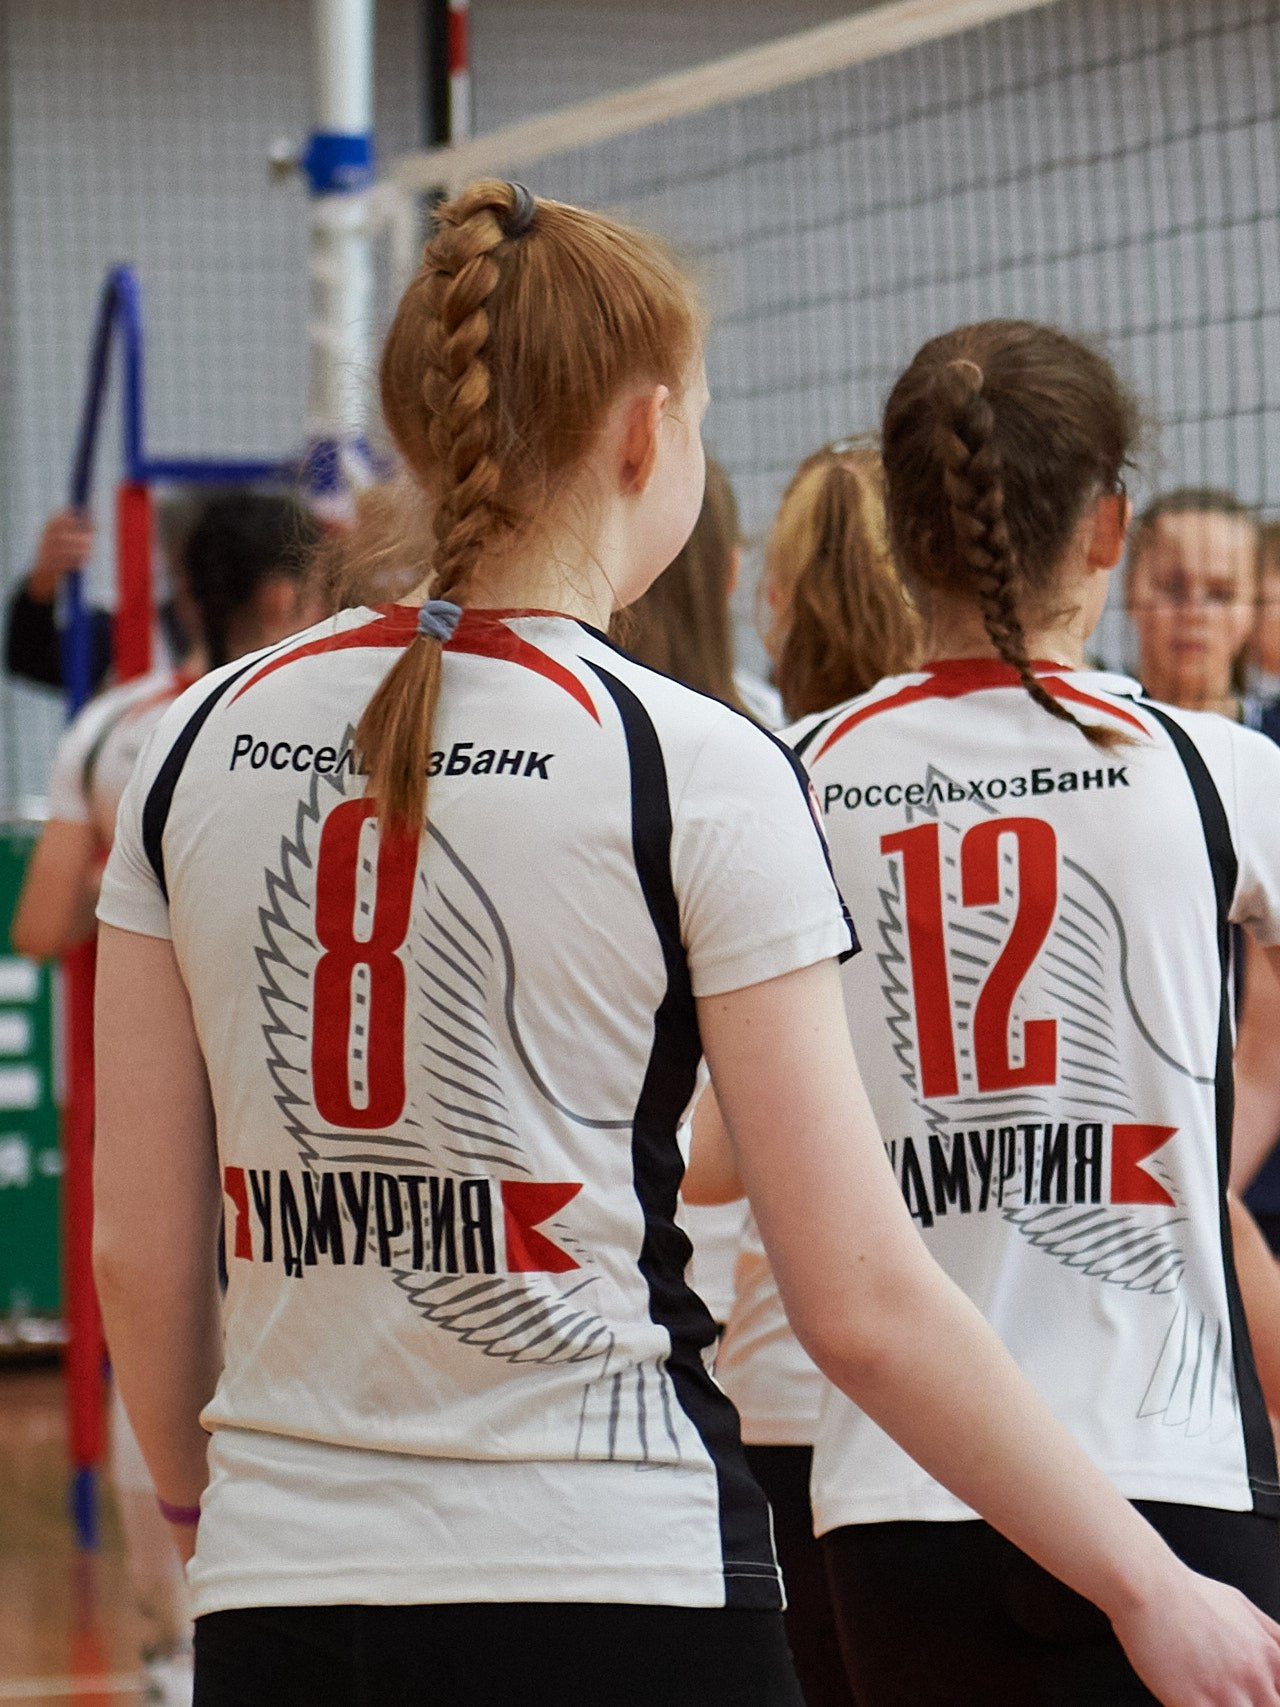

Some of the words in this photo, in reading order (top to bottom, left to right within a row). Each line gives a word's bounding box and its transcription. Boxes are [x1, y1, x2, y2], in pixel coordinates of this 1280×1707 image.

[229, 734, 554, 780] РосселзБанк
[824, 766, 1130, 813] РоссельхозБанк
[312, 797, 421, 1129] 8
[880, 817, 1057, 1098] 12
[248, 1169, 496, 1278] УДМУРТИЯ
